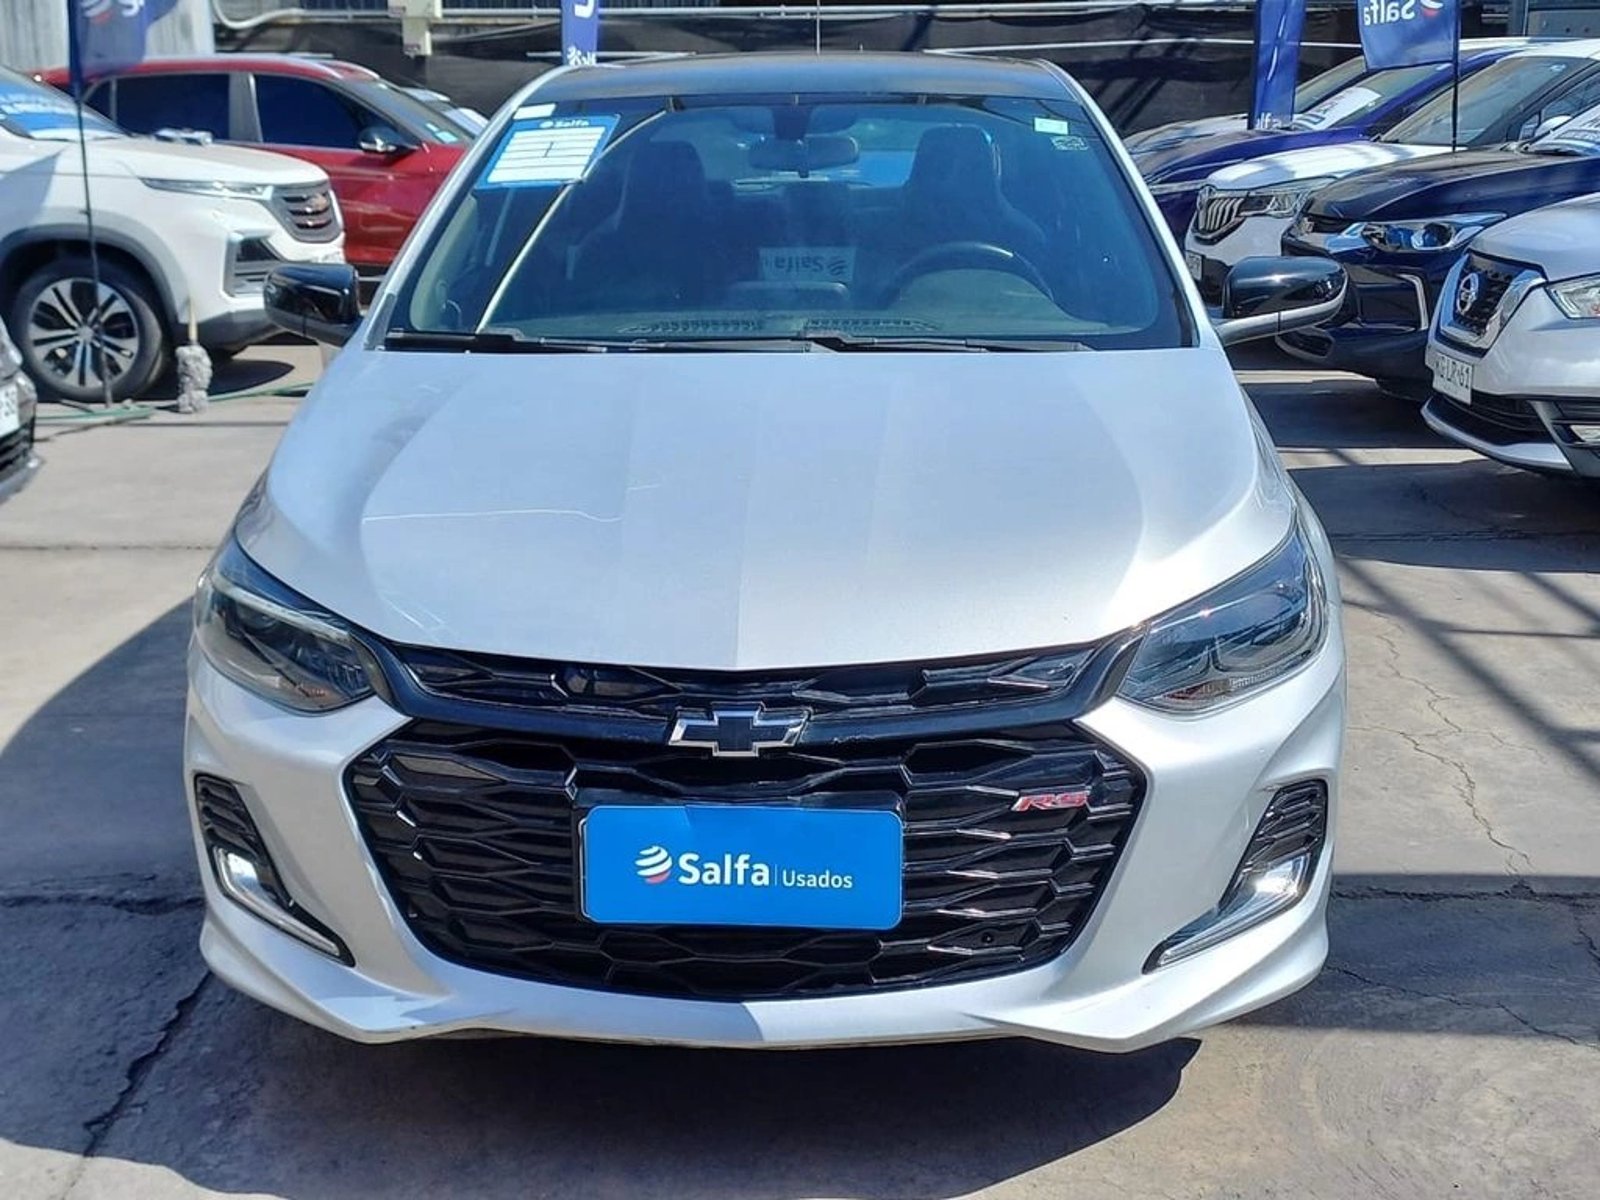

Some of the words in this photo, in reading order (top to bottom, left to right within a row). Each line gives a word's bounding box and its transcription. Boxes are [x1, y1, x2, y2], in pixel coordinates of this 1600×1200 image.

[1011, 790, 1087, 811] RS
[678, 852, 770, 887] Salfa
[782, 869, 854, 889] Usados
